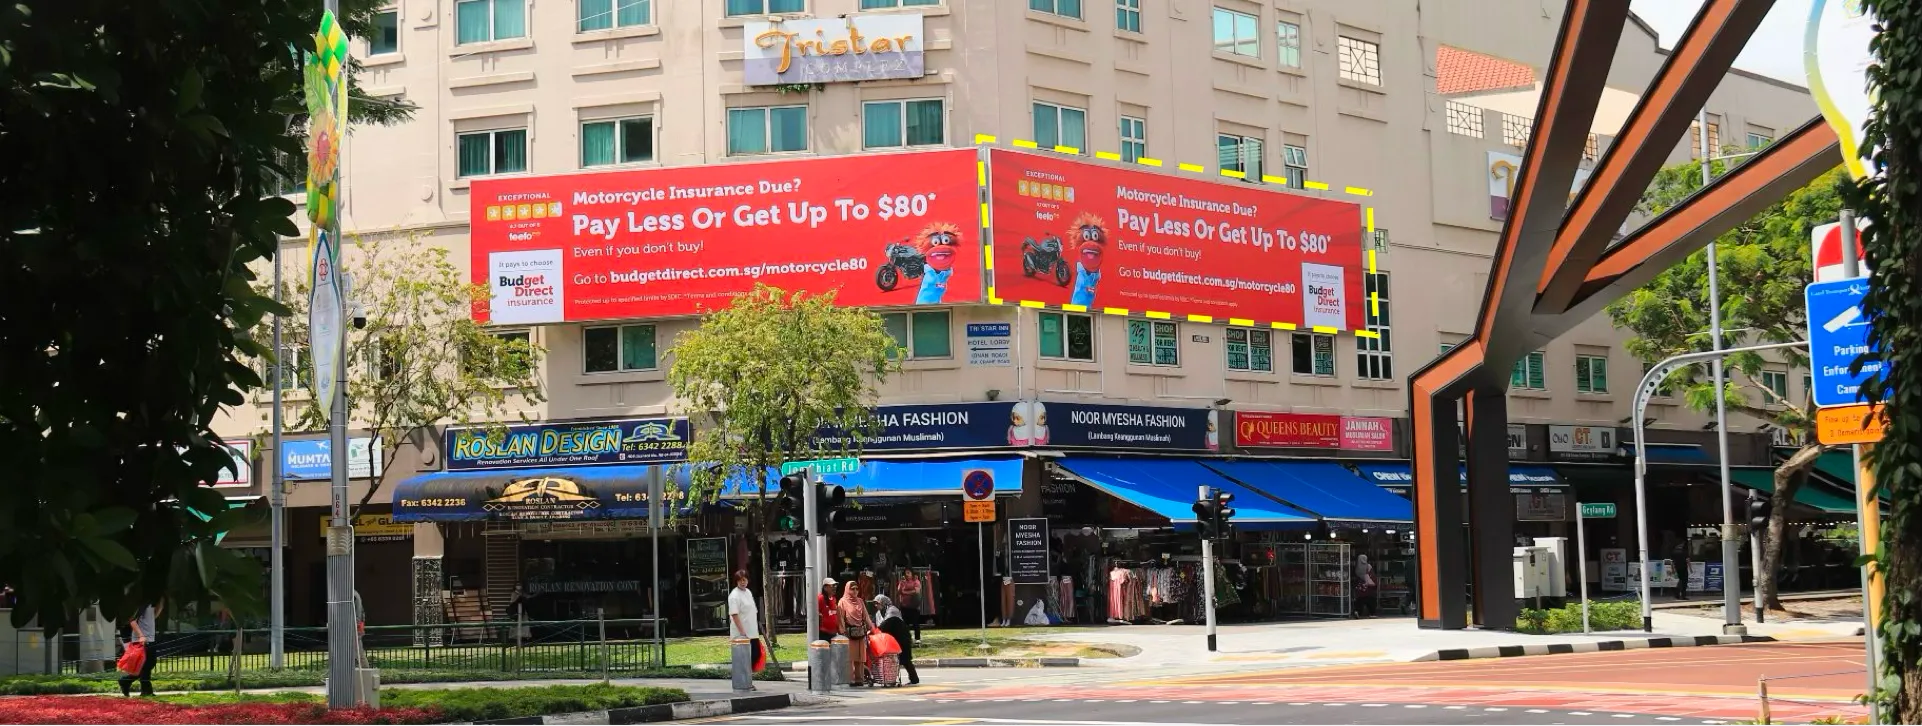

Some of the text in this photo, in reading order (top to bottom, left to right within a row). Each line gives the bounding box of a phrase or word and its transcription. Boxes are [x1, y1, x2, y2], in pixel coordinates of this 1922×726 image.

[755, 25, 913, 74] Tristar
[1026, 170, 1066, 183] EXCEPTIONAL
[498, 192, 551, 201] EXCEPTIONAL
[572, 178, 802, 206] Motorcycle Insurance Due?
[1116, 185, 1258, 218] Motorcycle Insurance Due?
[572, 214, 621, 240] Pay
[627, 211, 685, 233] Less
[691, 207, 727, 230] Or
[733, 203, 781, 228] Get
[787, 201, 828, 228] Up
[834, 198, 870, 222] To
[508, 231, 533, 241] feefo
[1117, 207, 1150, 237] Pay
[1153, 212, 1191, 238] Less
[1194, 218, 1215, 241] Or
[1218, 222, 1248, 245] Get
[1250, 226, 1274, 252] Up
[1276, 229, 1297, 251] To
[573, 240, 704, 258] Even if you don't buy!
[1118, 239, 1202, 262] Even if you don't buy!
[505, 261, 520, 269] pays
[573, 258, 868, 285] Go to budgetdirect.com.sg/motorcycle80
[500, 274, 545, 288] Budget
[1119, 266, 1131, 278] Go
[1132, 268, 1142, 279] to
[1142, 267, 1296, 296] budgetdirect.com.sg/motorcycle80
[514, 286, 554, 297] Direct
[1308, 285, 1335, 298] Budget
[507, 298, 554, 307] insurance
[1317, 296, 1340, 307] Direct
[1313, 305, 1340, 315] insurance
[1155, 324, 1174, 333] SHOP
[1227, 330, 1244, 339] SHOP
[1833, 344, 1870, 357] Parking
[1823, 361, 1882, 377] Enforment
[902, 411, 969, 427] FASHION
[1071, 410, 1186, 428] NOOR MYESHA FASHION
[1345, 420, 1379, 431] JANNAH
[1256, 420, 1339, 440] QUEENS BEAUTY
[1575, 427, 1591, 445] CT
[903, 431, 944, 443] Muslimah)
[454, 428, 622, 460] ROSLAN DESIGN
[622, 443, 637, 452] Tel:
[638, 442, 660, 451] 6342
[287, 452, 332, 465] MUMTA
[477, 458, 511, 466] Renovation
[512, 457, 538, 465] Services
[583, 454, 599, 463] Roof
[841, 460, 855, 472] Rd
[1040, 484, 1076, 493] FASHION
[401, 499, 419, 507] Fax:
[421, 498, 443, 507] 6342
[525, 497, 556, 505] ROSLAN
[615, 493, 633, 502] Tel:
[1582, 505, 1614, 516] Geylang Rd
[1015, 531, 1041, 539] MYESHA
[529, 581, 562, 593] ROSLAN
[564, 580, 614, 593] RENOVATION
